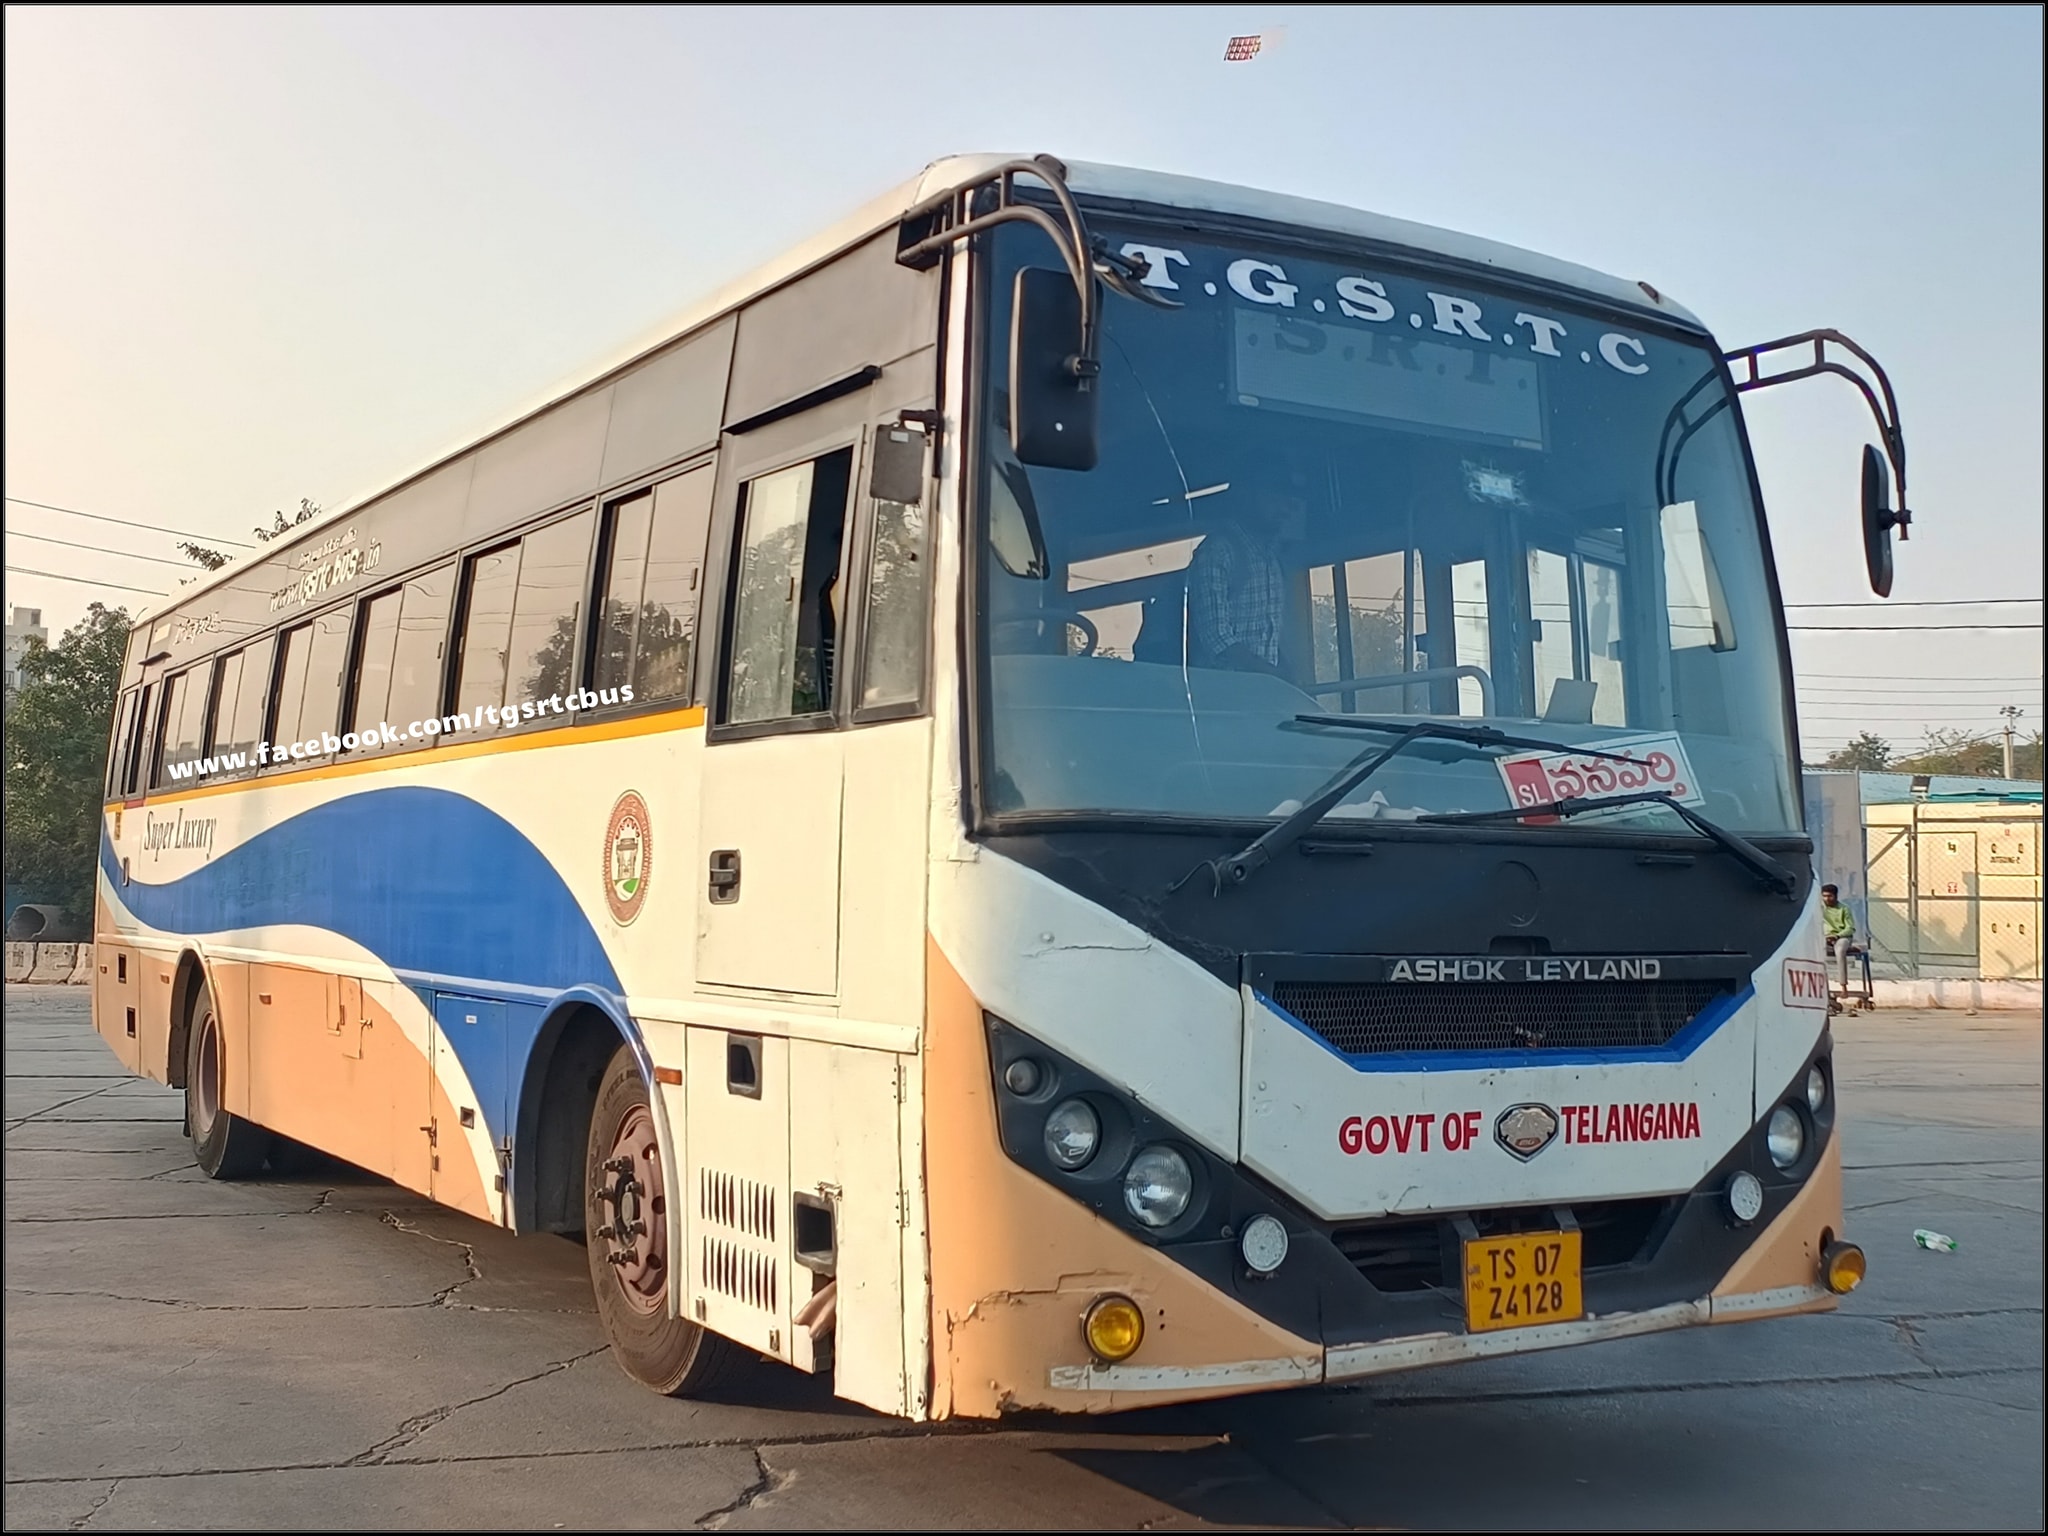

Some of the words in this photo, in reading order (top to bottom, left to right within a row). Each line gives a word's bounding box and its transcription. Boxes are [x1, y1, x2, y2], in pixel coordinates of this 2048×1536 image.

[1518, 783, 1548, 807] SL
[144, 810, 175, 863] Super
[174, 807, 217, 862] Luxury
[1390, 959, 1506, 982] ASHOK
[1525, 958, 1661, 981] LEYLAND
[1787, 968, 1825, 999] WNP
[1338, 1113, 1436, 1155] GOVT
[1442, 1111, 1482, 1152] OF
[1560, 1102, 1702, 1144] TELANGANA
[1487, 1247, 1517, 1281] TS
[1533, 1243, 1562, 1276] 07
[1488, 1280, 1563, 1320] Z4128
